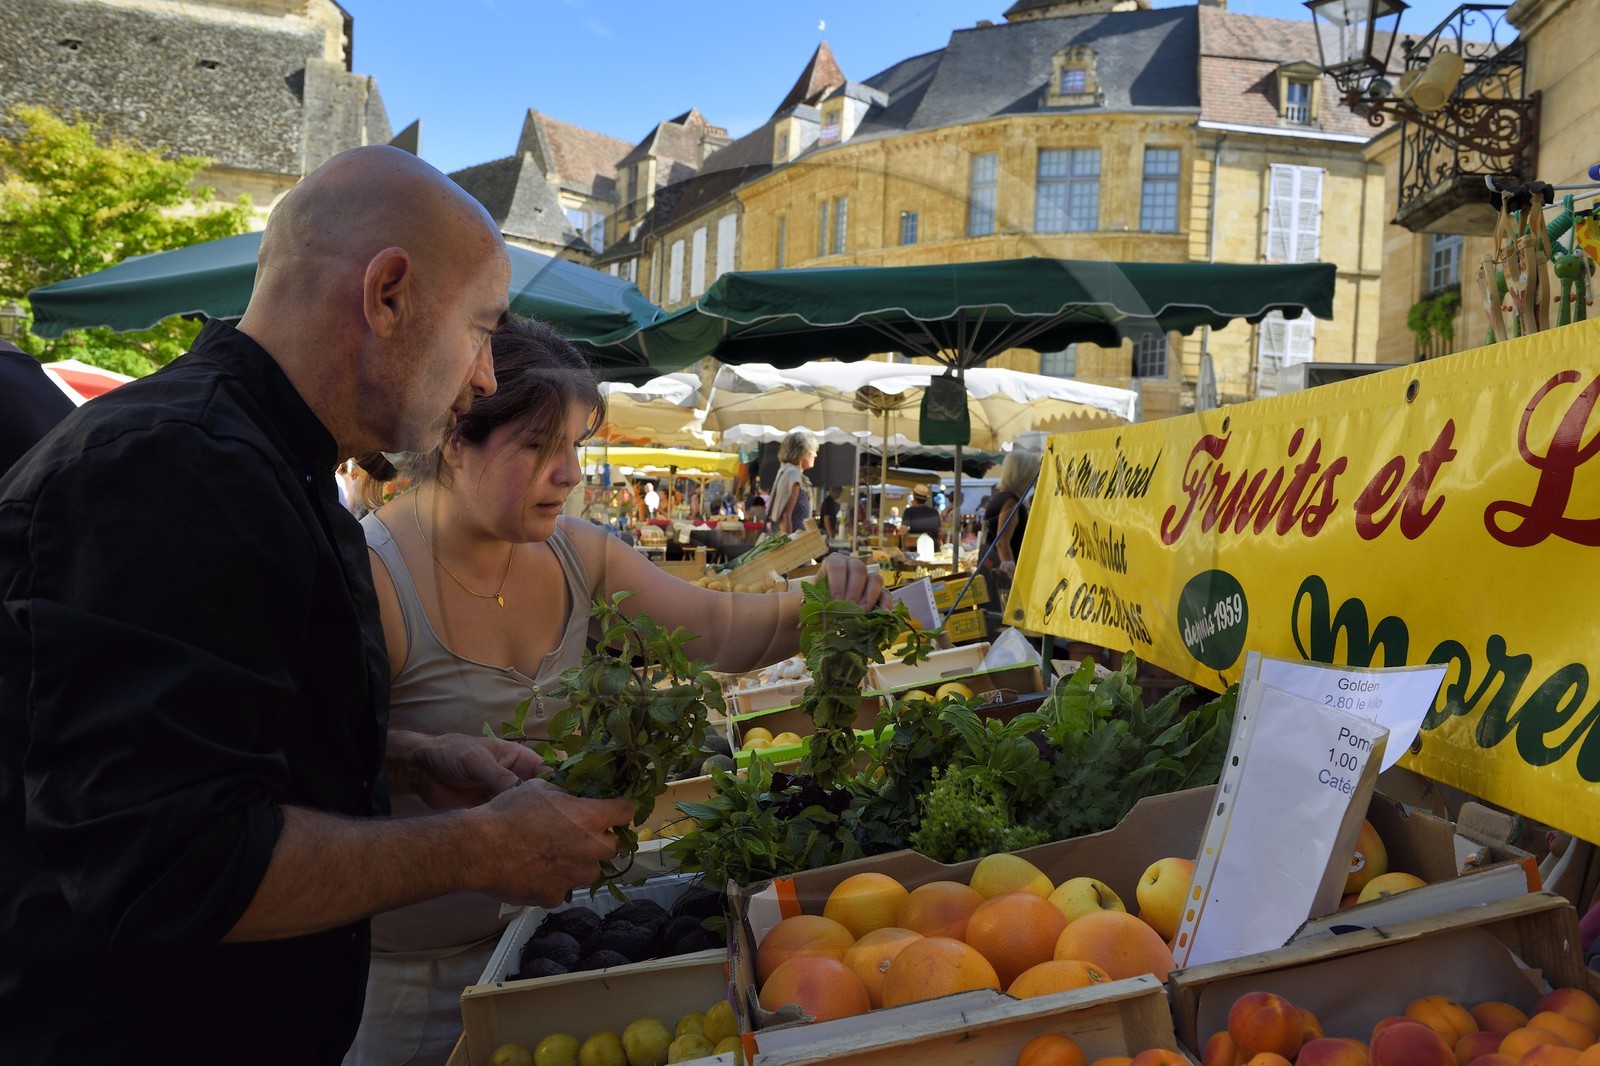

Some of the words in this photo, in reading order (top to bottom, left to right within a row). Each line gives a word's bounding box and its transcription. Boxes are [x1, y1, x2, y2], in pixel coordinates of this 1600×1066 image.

[1160, 428, 1348, 546] Fruits
[1353, 418, 1457, 540] et
[1184, 607, 1215, 653] depuis
[1214, 593, 1243, 632] 1959
[1291, 574, 1600, 783] More
[1337, 677, 1380, 692] Golden
[1325, 694, 1354, 710] 2.80
[1356, 698, 1366, 710] le
[1328, 747, 1358, 772] 1,00
